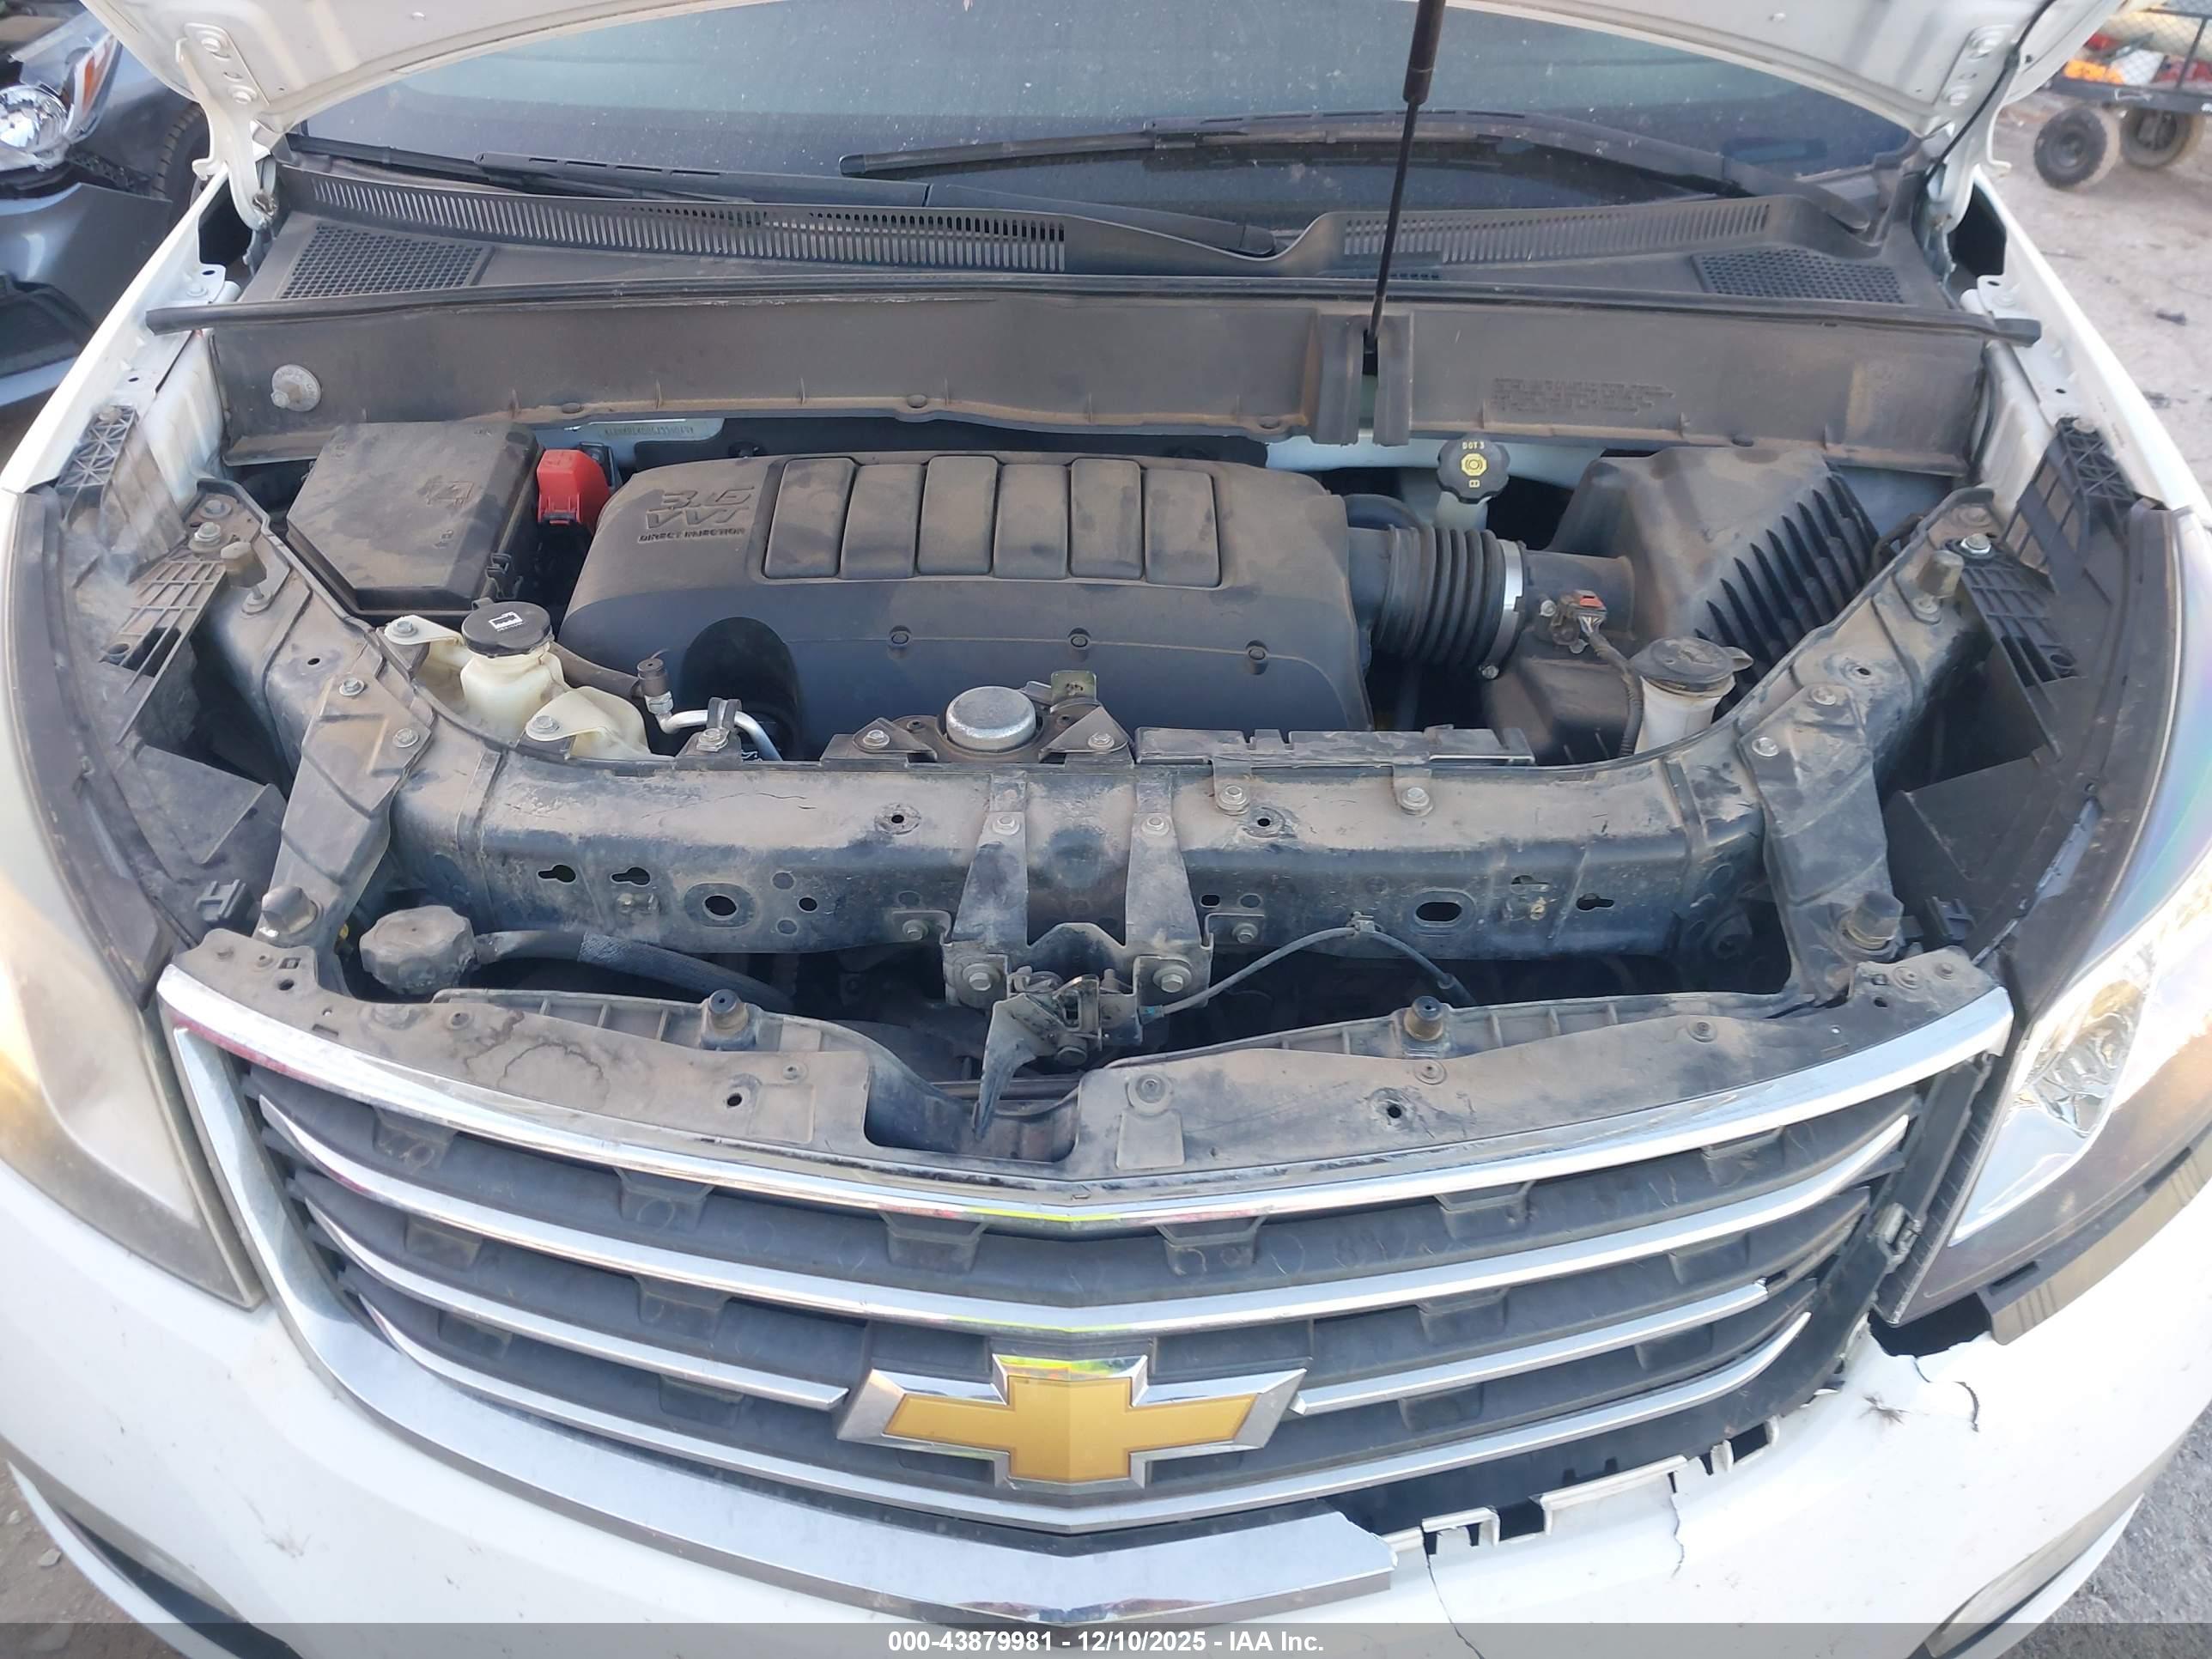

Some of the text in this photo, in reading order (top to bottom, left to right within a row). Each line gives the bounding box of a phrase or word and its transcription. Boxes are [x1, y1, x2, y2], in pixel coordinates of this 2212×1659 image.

[661, 488, 755, 508] 3.6
[646, 505, 750, 529] VVT
[638, 527, 746, 543] DIRECT INJECTION
